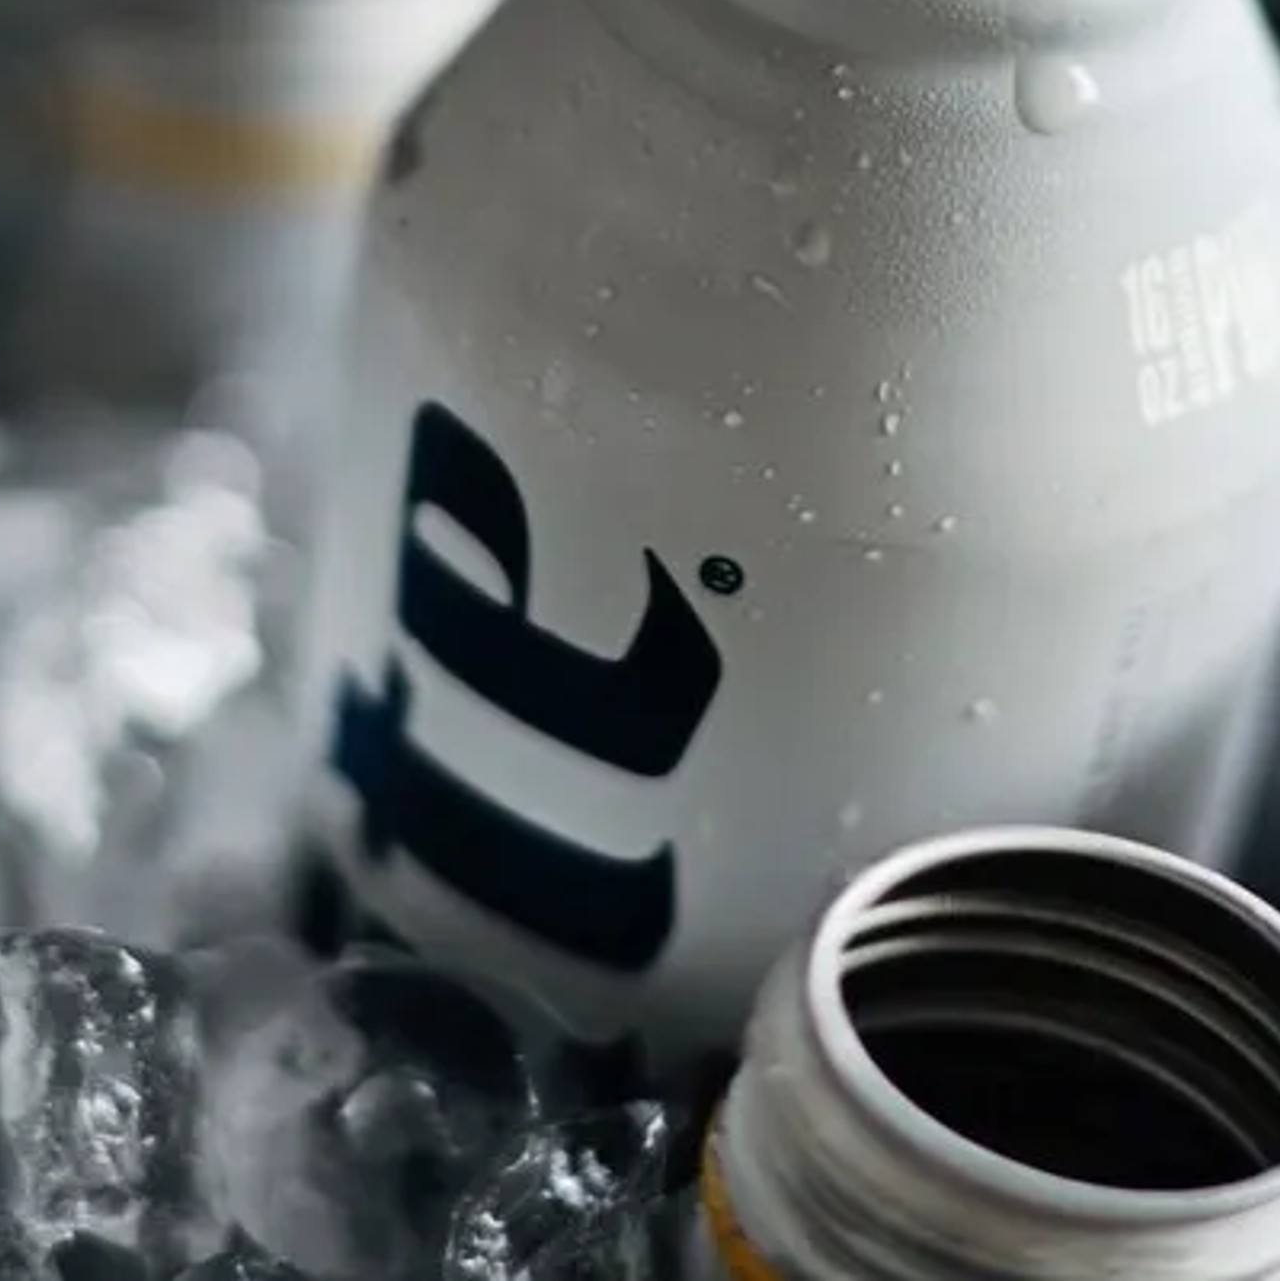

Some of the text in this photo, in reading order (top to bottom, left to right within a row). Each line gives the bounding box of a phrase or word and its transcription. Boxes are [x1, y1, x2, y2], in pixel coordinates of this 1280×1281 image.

[1119, 255, 1171, 356] 16
[1137, 358, 1186, 427] OZ
[326, 400, 722, 975] te
